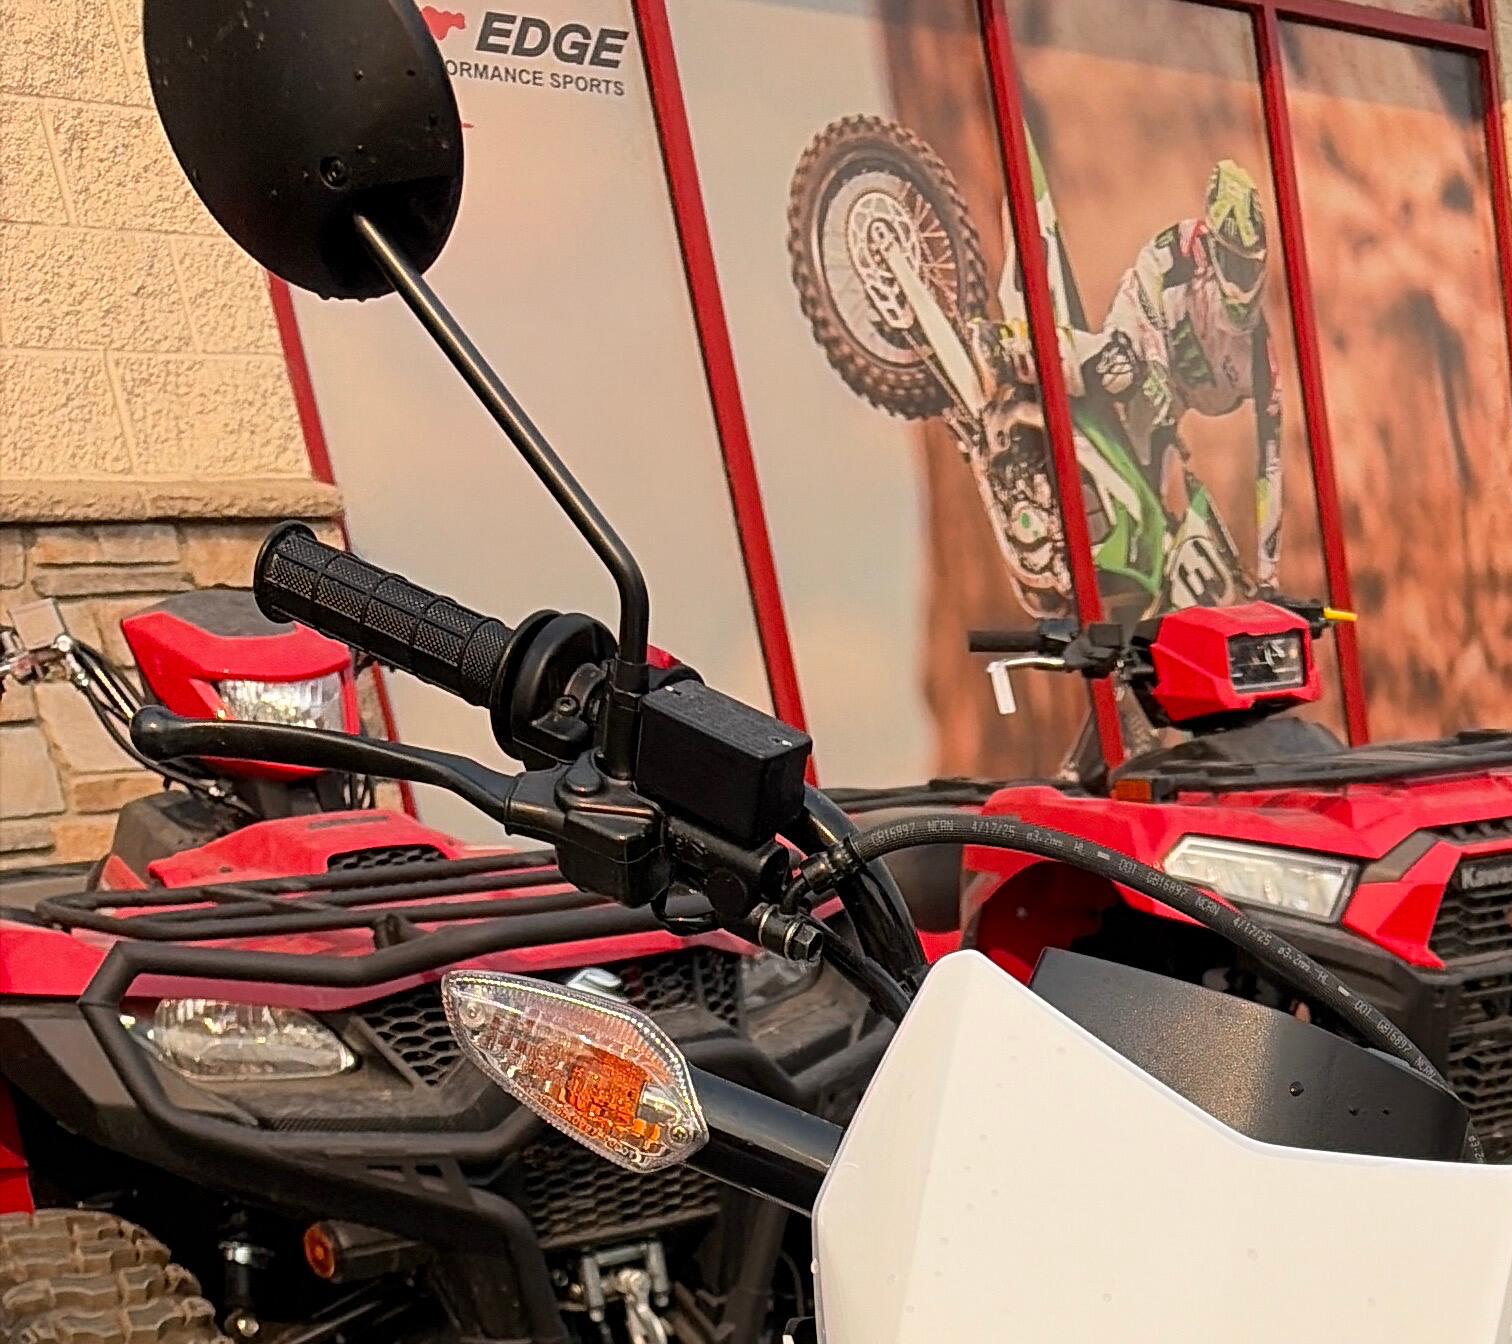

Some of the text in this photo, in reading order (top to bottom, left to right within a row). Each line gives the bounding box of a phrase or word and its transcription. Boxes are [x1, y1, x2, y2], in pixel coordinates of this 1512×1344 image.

[475, 11, 630, 69] EDGE
[444, 59, 624, 96] ORMANCE SPORTS
[1232, 915, 1273, 946] 4/17/25
